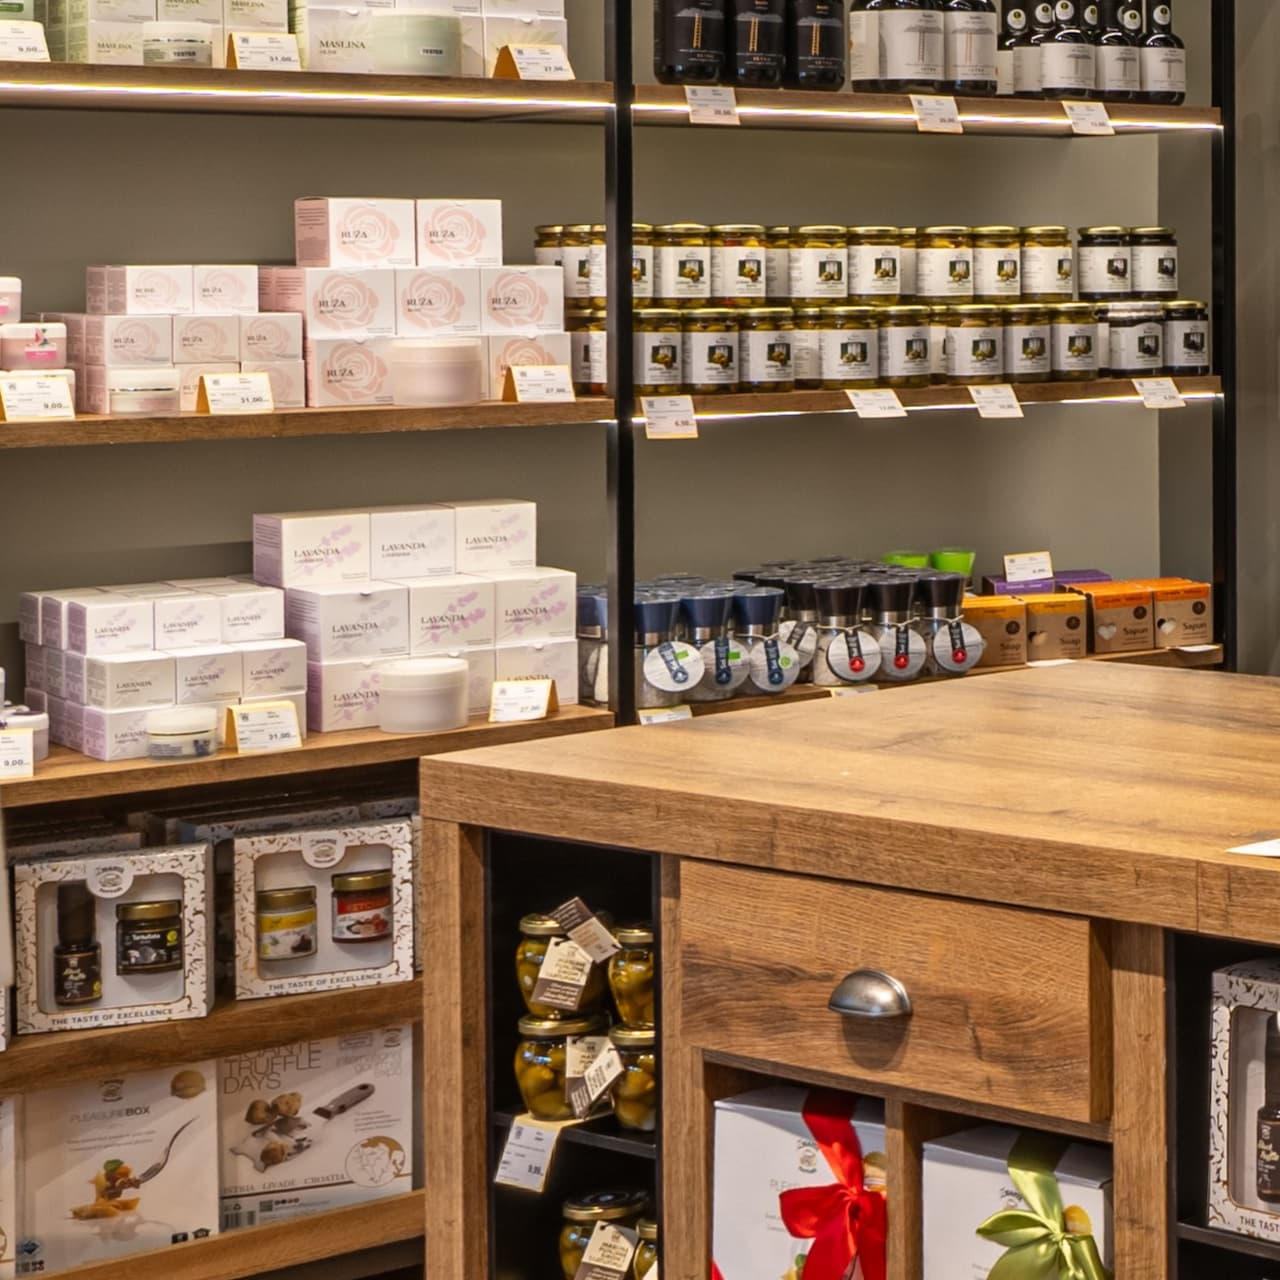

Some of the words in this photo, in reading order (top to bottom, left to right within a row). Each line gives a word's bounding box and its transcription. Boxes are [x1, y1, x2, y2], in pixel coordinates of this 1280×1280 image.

[319, 40, 366, 49] MASLINA
[465, 535, 508, 545] LAVANDA
[294, 547, 341, 558] LAVANDA
[381, 542, 426, 552] LAVANDA
[504, 607, 548, 617] LAVANDA
[421, 614, 466, 624] LAVANDA
[332, 622, 379, 633] LAVANDA
[269, 983, 285, 991] THE
[288, 980, 314, 990] TASTE
[316, 979, 328, 987] OF
[330, 972, 383, 985] EXCELLENCE
[51, 1017, 70, 1026] THE
[72, 1015, 100, 1024] TASTE
[102, 1013, 114, 1021] OF
[117, 1008, 173, 1020] EXCELLENCE
[224, 1051, 321, 1078] TRUFFLE
[224, 1072, 281, 1094] DAYS
[1240, 1216, 1256, 1228] THE
